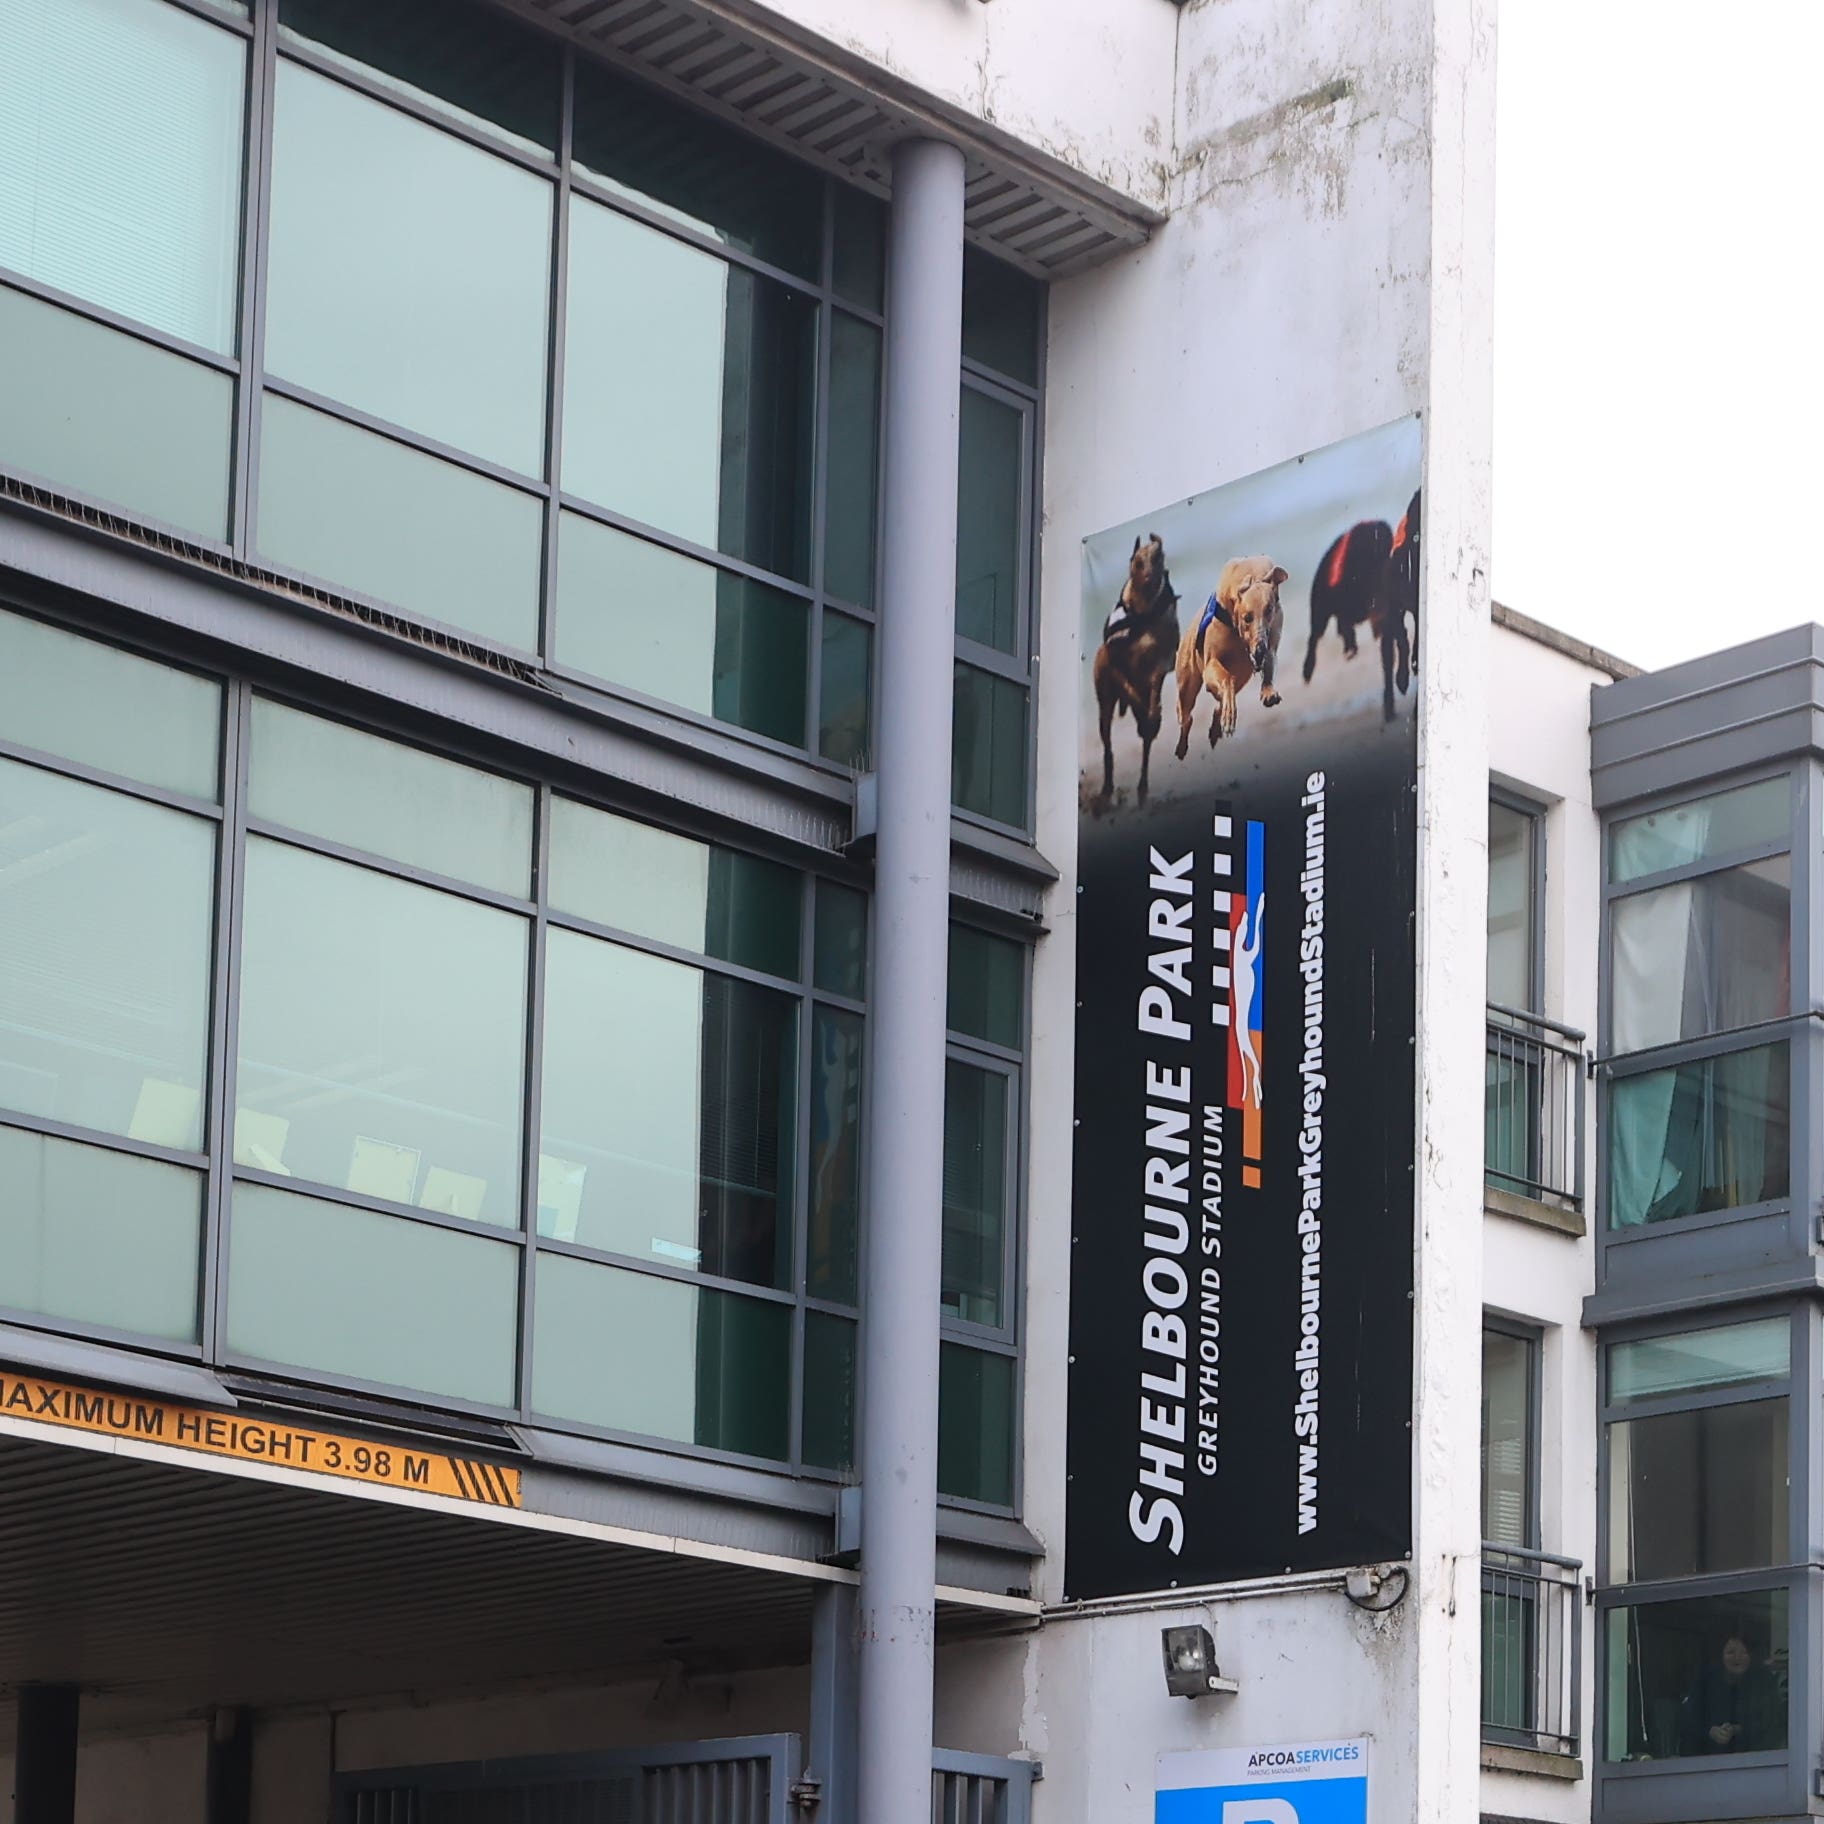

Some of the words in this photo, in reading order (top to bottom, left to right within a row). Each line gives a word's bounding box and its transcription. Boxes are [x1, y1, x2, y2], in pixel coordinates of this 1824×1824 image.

[1137, 843, 1197, 1042] PARK
[1200, 1104, 1224, 1259] STADIUM
[1295, 770, 1326, 1535] www.ShelbourneParkGreyhoundStadium.ie
[1129, 1059, 1192, 1556] SHELBOURNE
[1197, 1266, 1223, 1477] GREYHOUND
[175, 1413, 317, 1465] HEIGHT
[322, 1441, 392, 1477] 3.98
[402, 1456, 430, 1485] M
